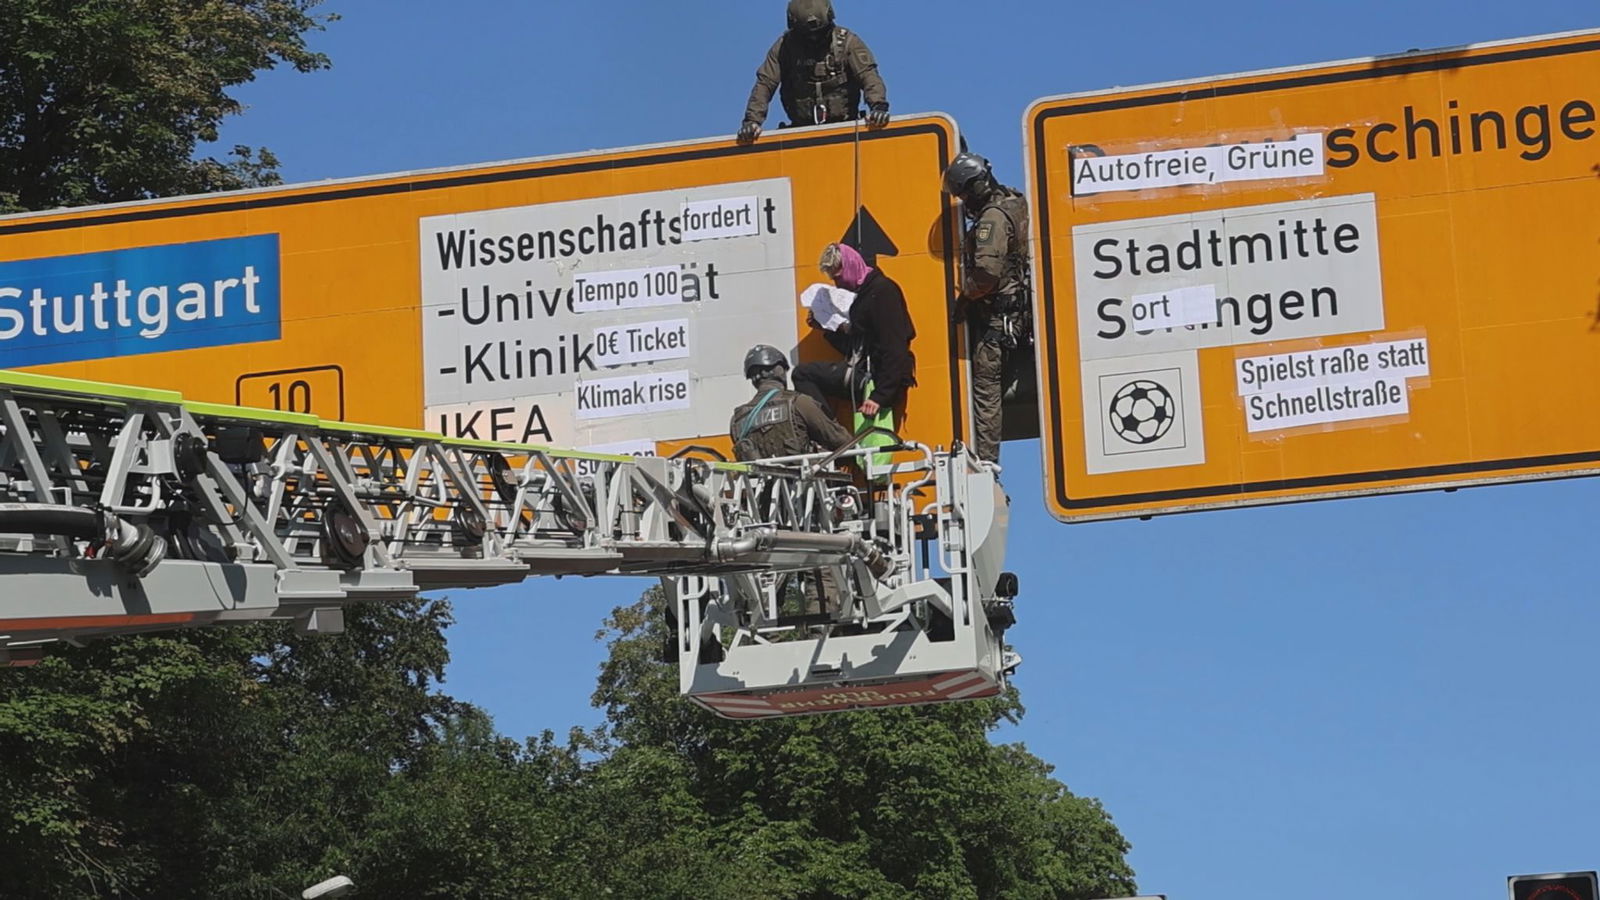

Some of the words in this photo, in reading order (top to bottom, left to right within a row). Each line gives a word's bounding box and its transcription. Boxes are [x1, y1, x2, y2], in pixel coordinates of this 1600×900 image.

[1077, 150, 1216, 184] Autofreie,
[1228, 144, 1315, 170] Grüne
[437, 198, 777, 271] Wissenschaftst
[682, 203, 752, 232] fordert
[1092, 217, 1360, 280] Stadtmitte
[0, 265, 261, 341] Stuttgart
[575, 278, 639, 306] Tempo
[643, 271, 678, 298] 100
[1132, 295, 1171, 320] ort
[1096, 284, 1339, 340] Sngen
[626, 325, 686, 353] Ticket
[1377, 342, 1426, 369] statt
[439, 333, 655, 386] -Klinik
[268, 379, 311, 414] 10
[1251, 379, 1402, 421] Schnellstraße
[440, 404, 553, 444] IKEA
